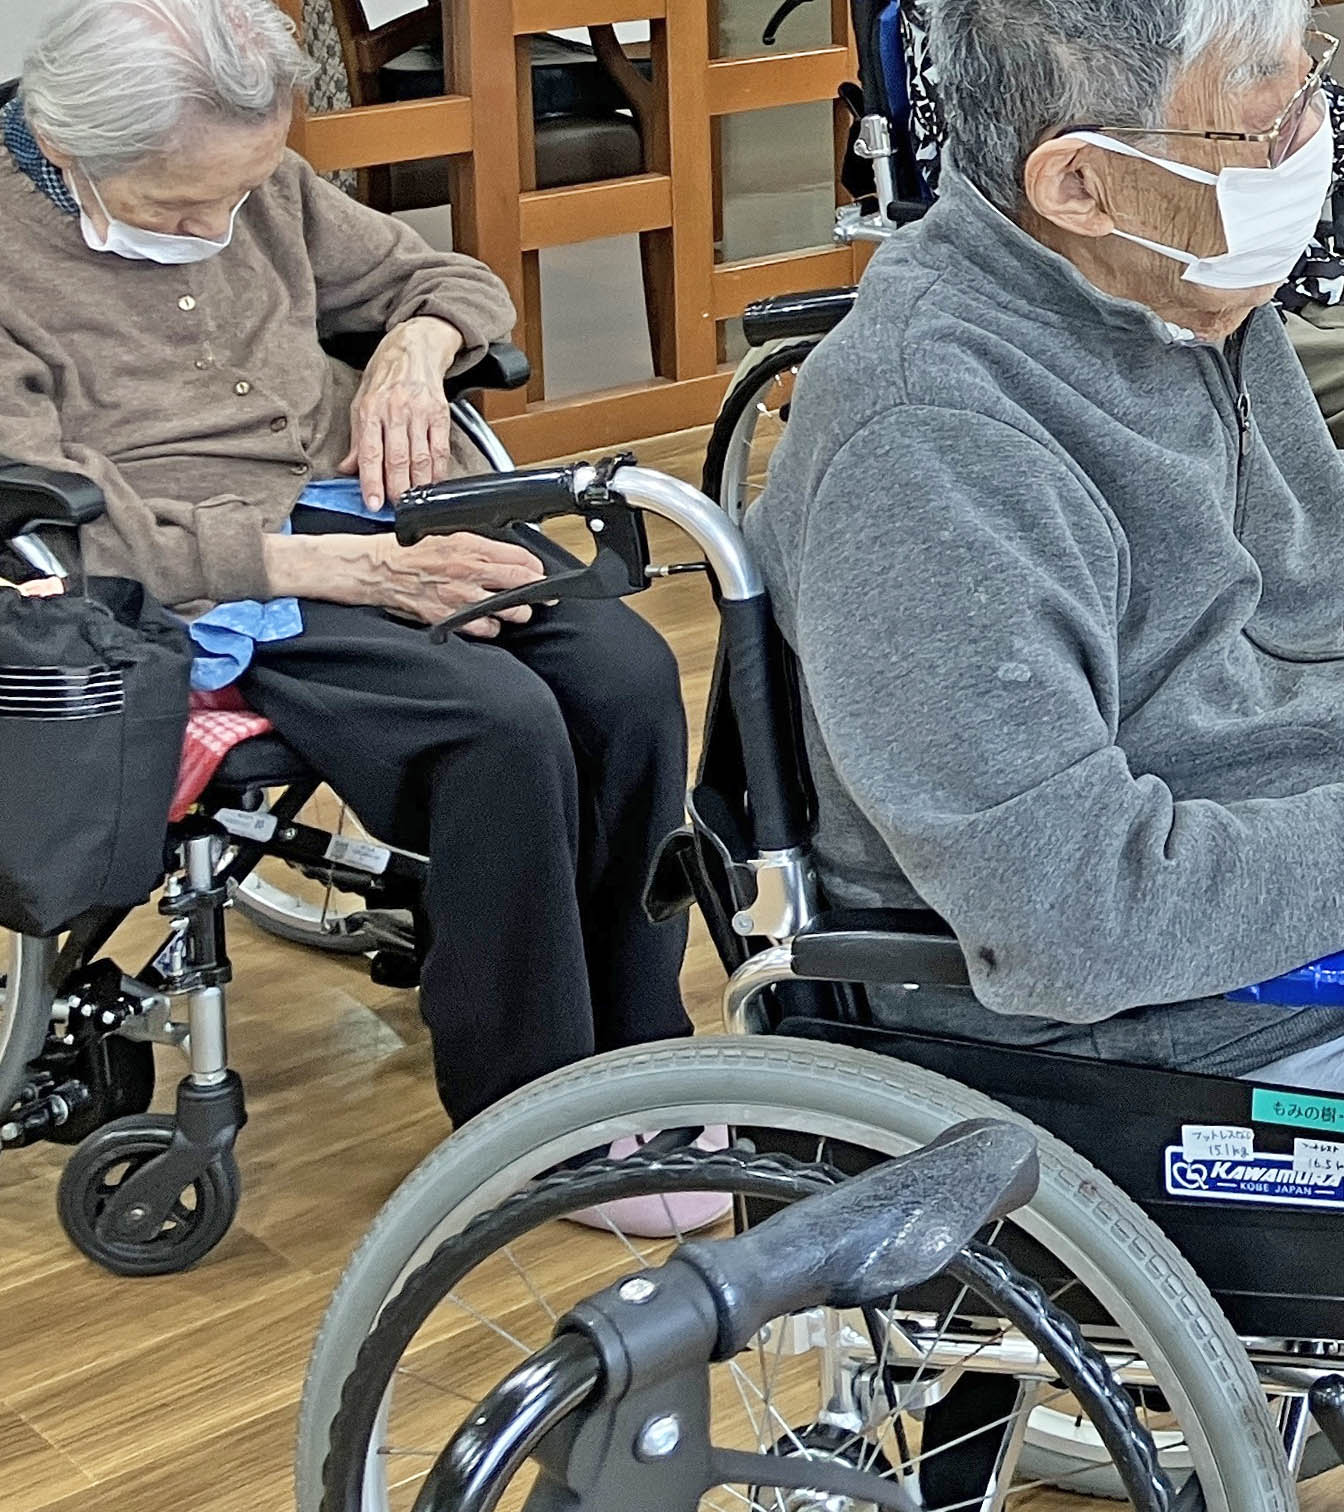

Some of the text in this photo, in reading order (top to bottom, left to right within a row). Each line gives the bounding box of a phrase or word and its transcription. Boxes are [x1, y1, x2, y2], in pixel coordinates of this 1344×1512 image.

[1210, 1161, 1342, 1187] KAWAMURA
[1239, 1181, 1313, 1196] KOBE JAPAN
